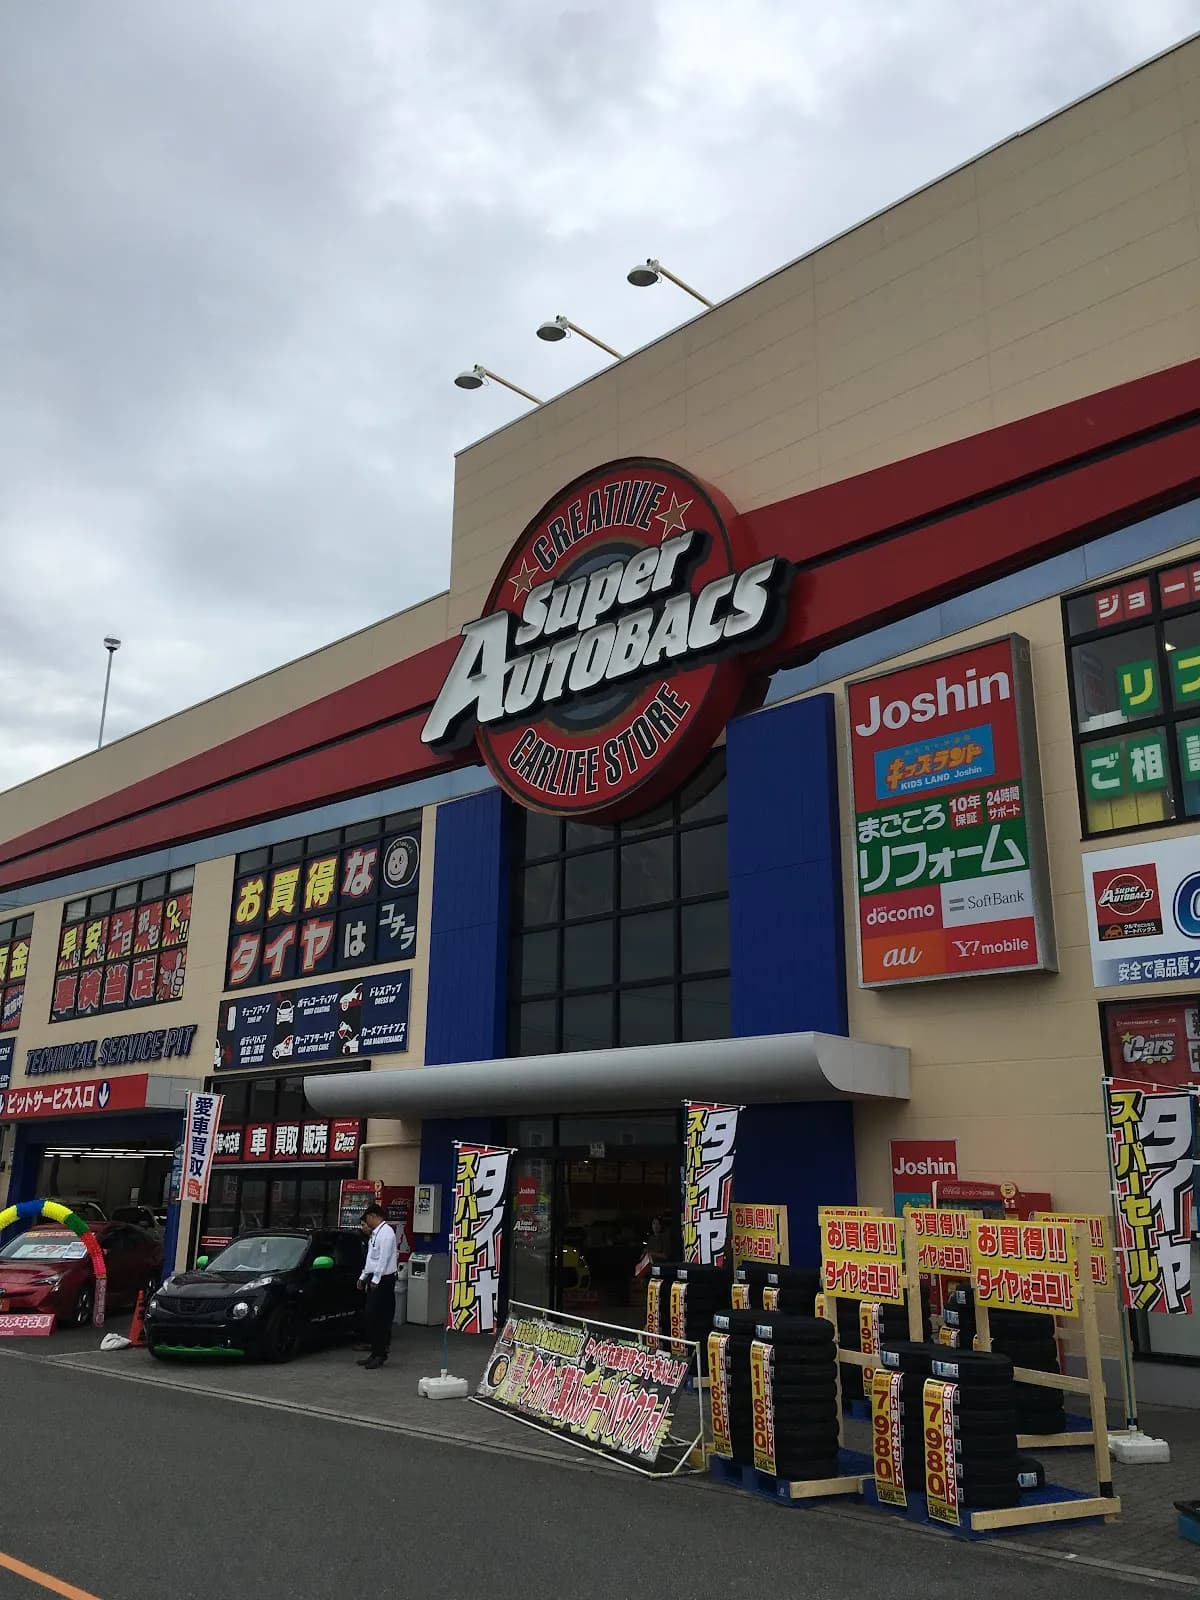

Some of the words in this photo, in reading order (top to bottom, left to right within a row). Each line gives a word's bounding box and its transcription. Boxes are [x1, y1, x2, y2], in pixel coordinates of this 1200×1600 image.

[532, 480, 667, 573] CREATIVE
[420, 558, 777, 743] AUTOBACS
[855, 668, 1011, 737] Joshin
[508, 727, 600, 796] CARLIFE
[603, 682, 691, 785] STORE
[901, 779, 923, 790] KIDS
[925, 773, 950, 785] LAND
[954, 766, 982, 778] Joshin
[950, 795, 981, 813] 10年
[986, 786, 1020, 807] 24時間
[989, 804, 1020, 820] サポート
[858, 804, 946, 844] まごころ
[955, 812, 978, 826] 保証
[860, 824, 1025, 892] リフォーム
[866, 904, 935, 925] docomo
[967, 889, 1025, 910] SoftBank
[883, 946, 922, 968] au
[1119, 956, 1200, 981] 安全で高品質・
[98, 1030, 166, 1066] SERVICE
[164, 1024, 198, 1058] PIT
[7, 1085, 95, 1114] ピットサービス入口
[189, 1096, 214, 1177] 愛車買取
[250, 1127, 267, 1156] 車
[275, 1126, 299, 1155] 買取
[302, 1123, 328, 1154] 販売
[894, 1157, 956, 1175] Joshin
[696, 1110, 738, 1264] タイヤ
[1139, 1096, 1192, 1308] タイヤ
[735, 1207, 775, 1230] お買得!!
[473, 1153, 509, 1329] タイヤ
[827, 1220, 897, 1255] お買得!!
[977, 1223, 1068, 1263] お買得!!
[917, 1243, 971, 1273] イヤはココ!
[825, 1260, 899, 1299] タイヤはココ!
[976, 1267, 1073, 1310] タイヤはココ!
